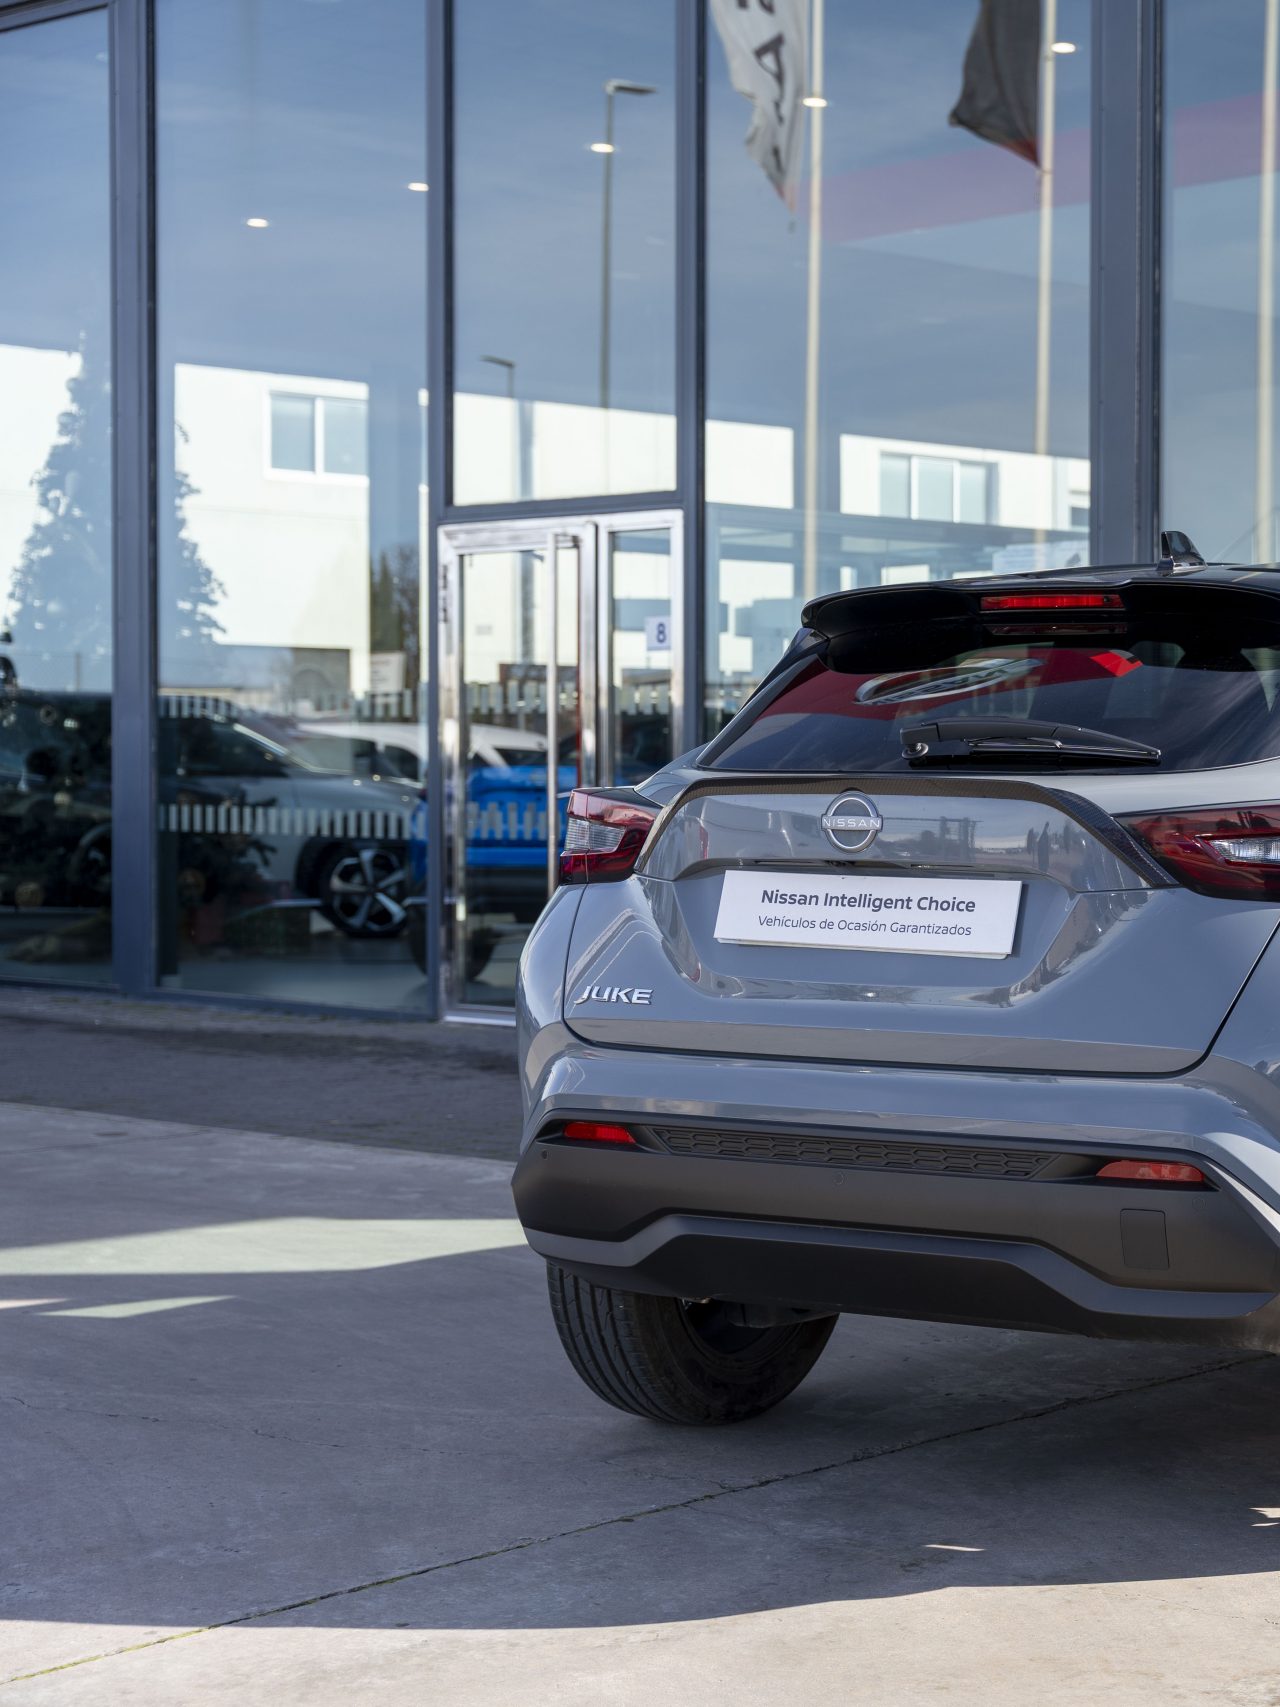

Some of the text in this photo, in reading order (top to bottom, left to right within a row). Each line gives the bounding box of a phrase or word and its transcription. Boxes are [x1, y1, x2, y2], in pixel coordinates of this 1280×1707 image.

[656, 621, 668, 644] 8
[823, 818, 881, 828] NISSAN
[761, 889, 976, 913] Nissan Intelligent Choice
[758, 915, 972, 937] Vehículos de Ocasión Garantizados
[573, 986, 653, 1005] JUKE
